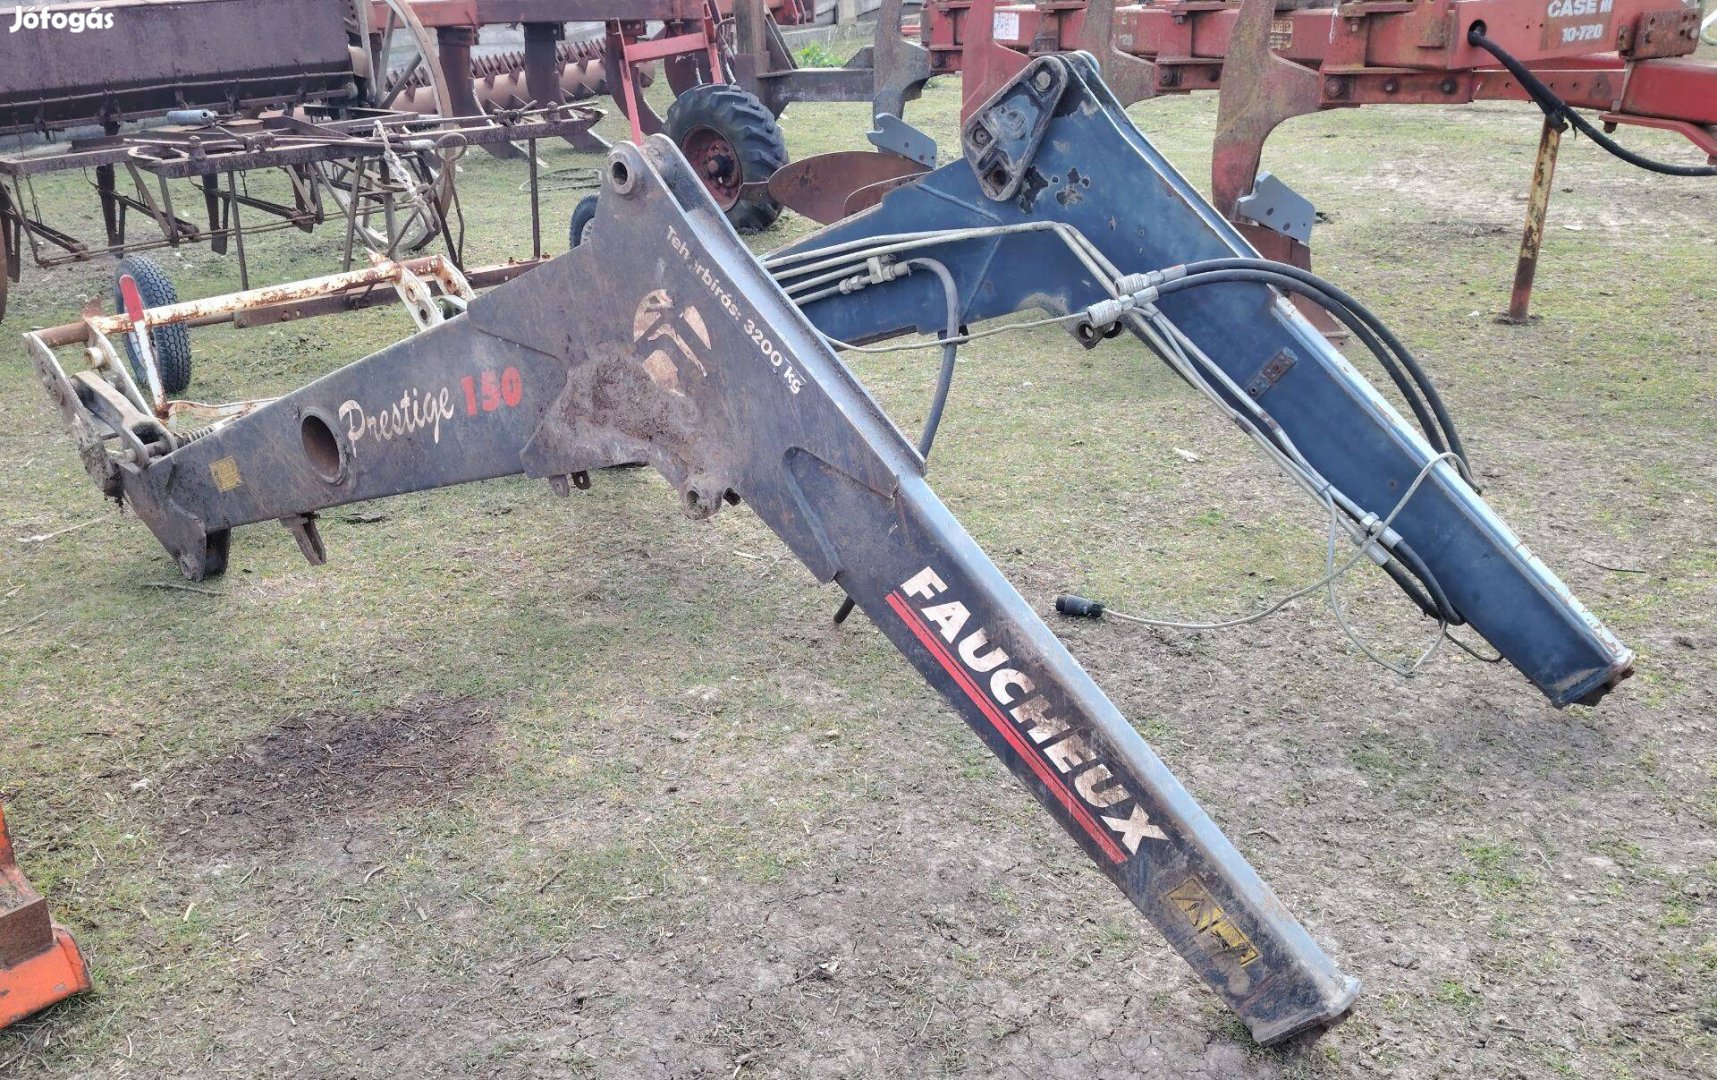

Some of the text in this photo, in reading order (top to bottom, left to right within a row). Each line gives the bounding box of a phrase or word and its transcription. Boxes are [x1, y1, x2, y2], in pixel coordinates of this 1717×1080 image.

[1548, 0, 1597, 17] CASE
[1562, 24, 1603, 42] 10-720
[666, 225, 802, 394] Tehrbírás: 3200 kg
[338, 366, 523, 458] Prestige 150
[900, 565, 1170, 856] FAUCHEUX
